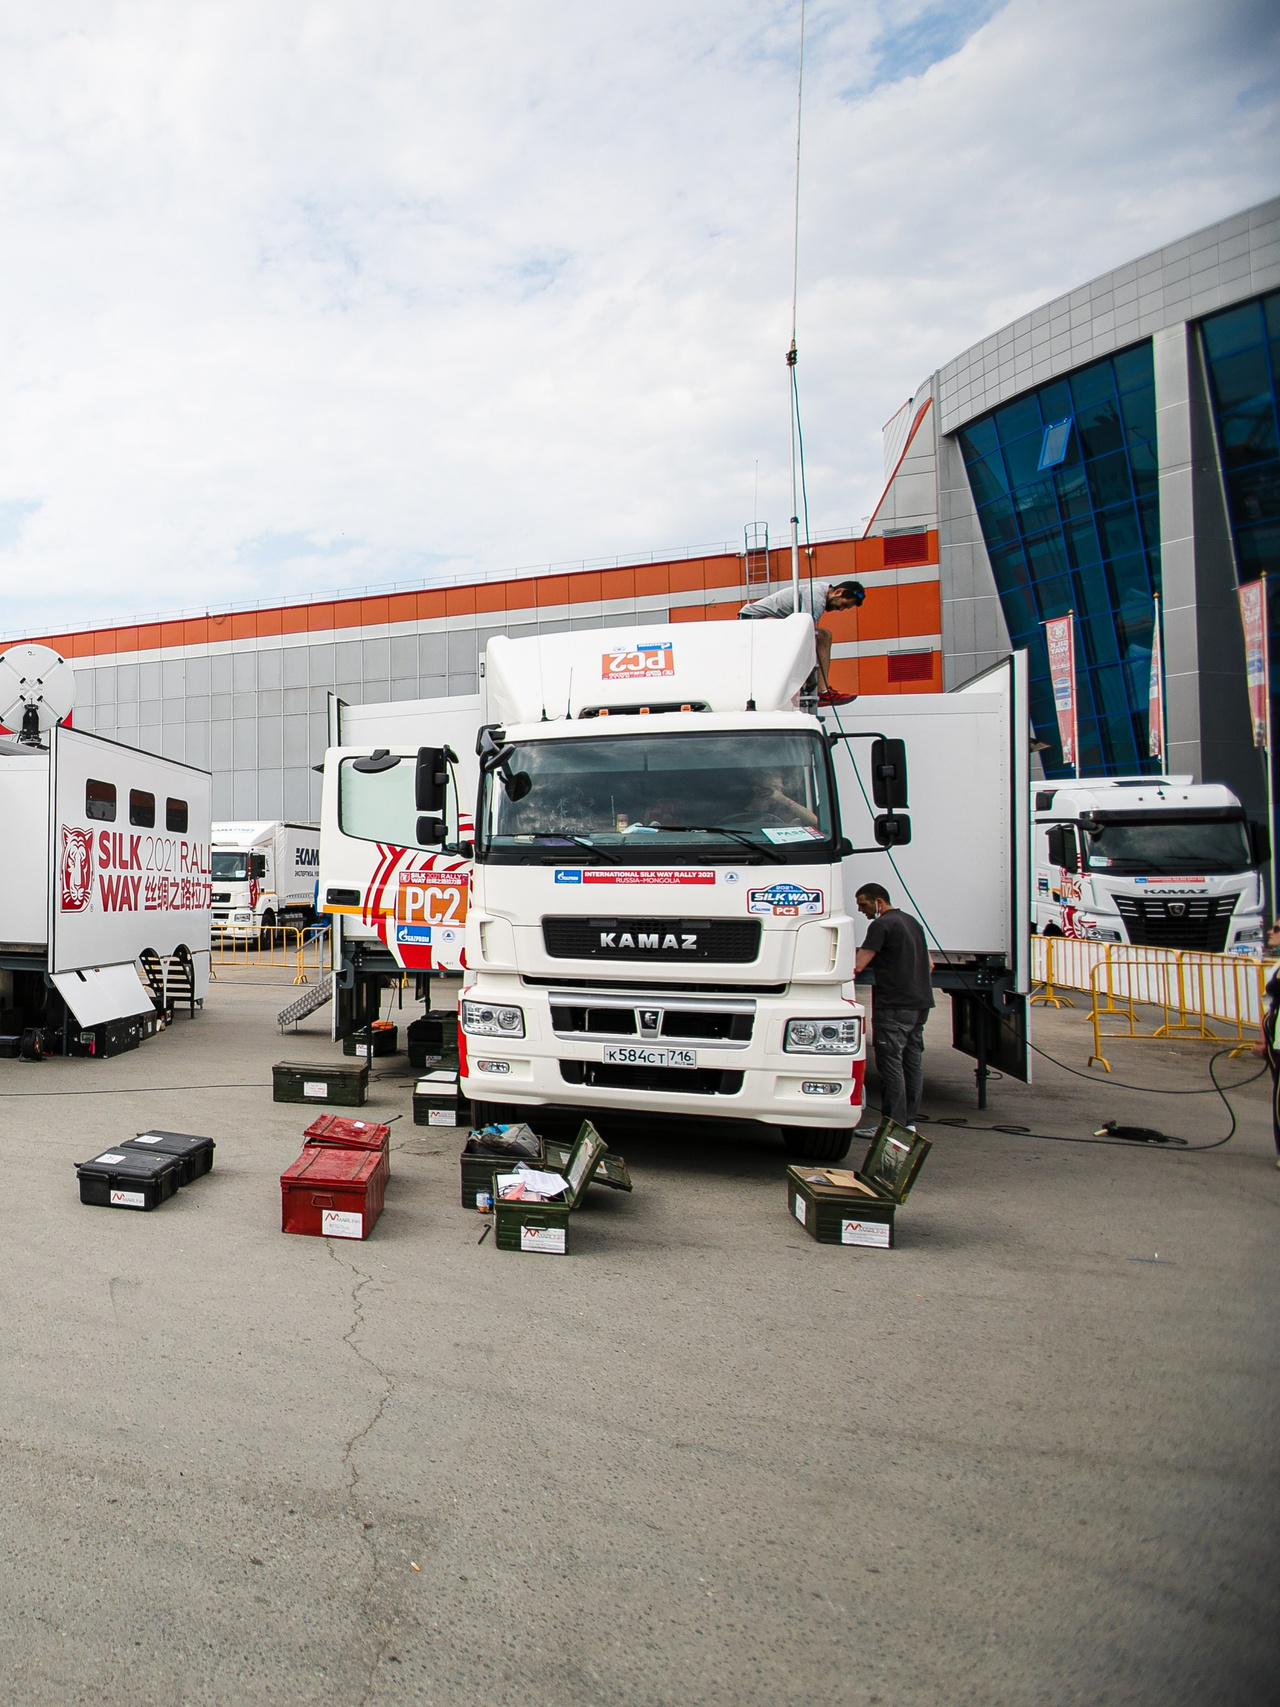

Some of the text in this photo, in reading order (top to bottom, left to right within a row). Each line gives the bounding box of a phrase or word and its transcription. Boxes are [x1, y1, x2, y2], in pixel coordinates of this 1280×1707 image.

[608, 650, 666, 673] PC2
[98, 830, 212, 875] SILK 2021 RALL
[295, 847, 320, 866] KAM
[98, 874, 143, 913] WAY
[754, 893, 817, 902] SILK WAY
[405, 885, 461, 926] PC2
[776, 907, 796, 915] PC2
[600, 932, 698, 950] KAMAZ
[608, 1048, 692, 1064] К584СТ 716
